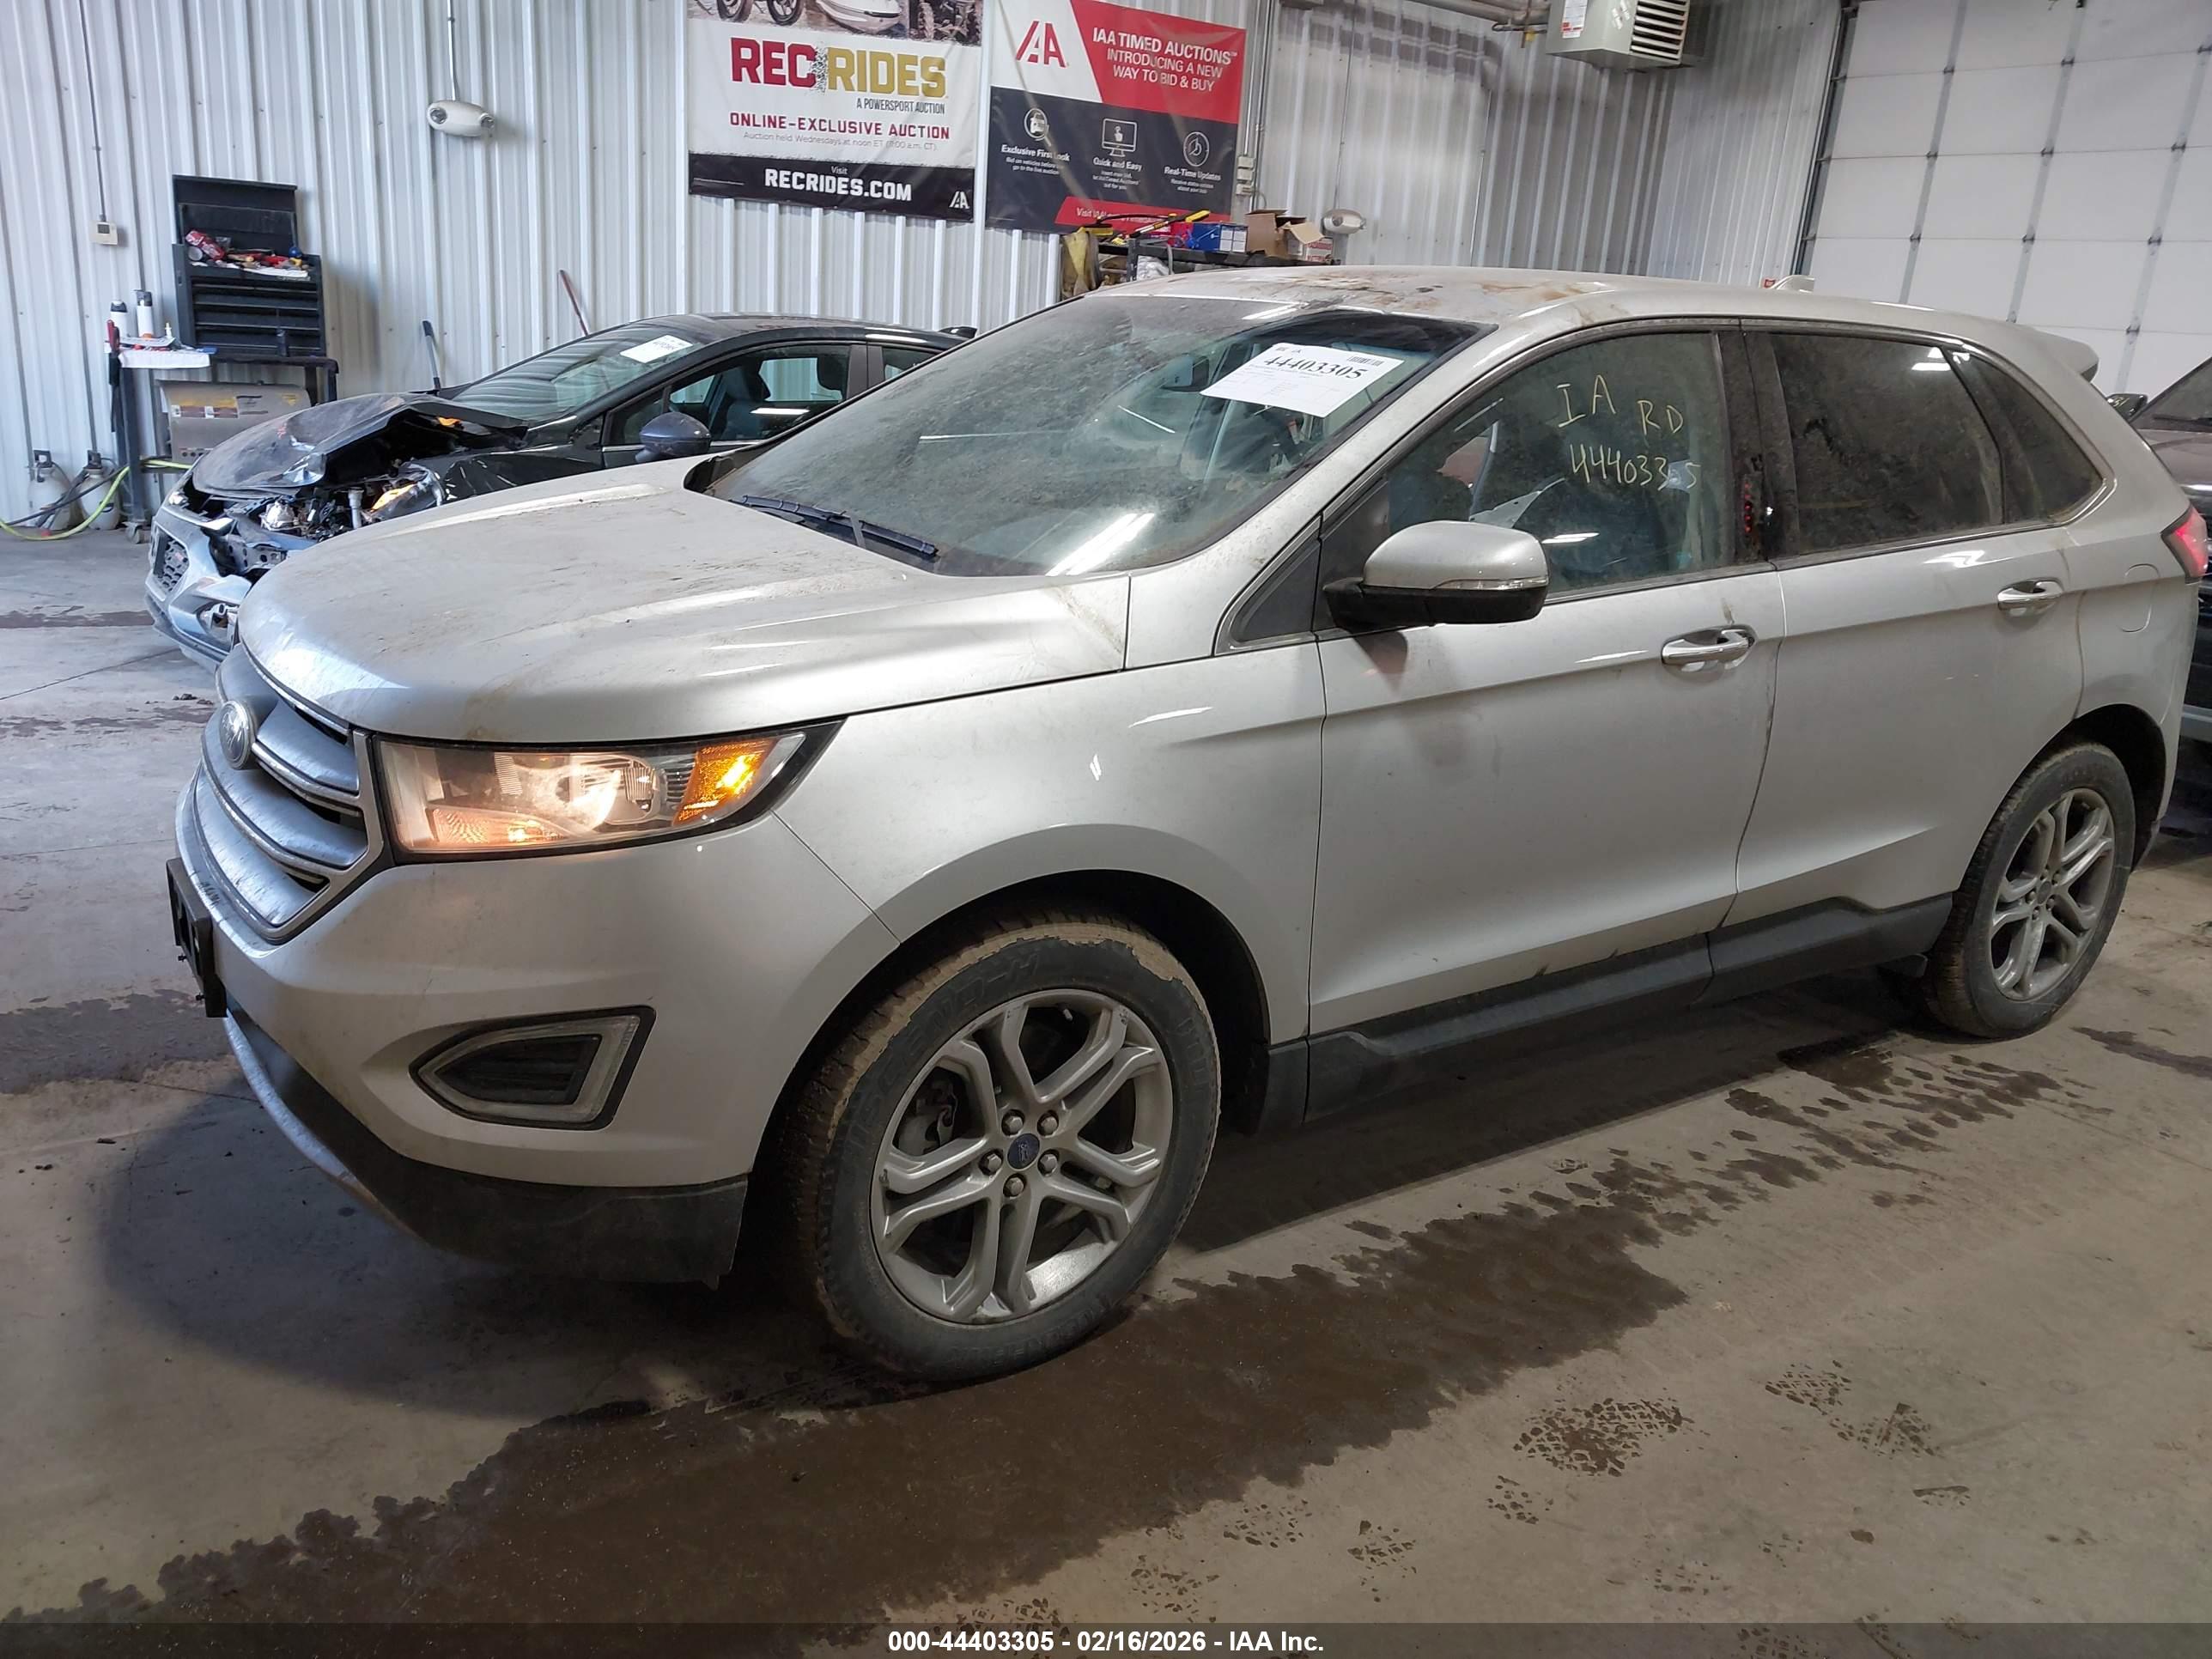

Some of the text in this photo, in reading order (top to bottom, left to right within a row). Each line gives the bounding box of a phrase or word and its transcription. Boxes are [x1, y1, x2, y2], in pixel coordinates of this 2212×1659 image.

[1092, 27, 1116, 46] IAA
[1118, 32, 1162, 52] TIMED
[1107, 48, 1223, 78] INTRODUCING A NEW
[1113, 64, 1215, 92] WAY TO BID & BUY
[857, 98, 945, 114] A POWERSPORT AUCTION
[730, 112, 951, 140] ONLINE-EXCLUSIVE AUCTION
[744, 131, 774, 142] Auction
[775, 133, 793, 143] held
[796, 135, 842, 146] Wednesdays
[852, 138, 871, 147] noon
[873, 139, 884, 148] ET
[1001, 144, 1036, 157] Exclusive
[831, 166, 848, 175] Visit
[1093, 157, 1111, 167] Quick
[1126, 161, 1142, 172] Easy
[1164, 166, 1221, 181] Real-Time Updates
[764, 168, 912, 202] RECRIDES.COM
[1076, 207, 1092, 218] Visit
[1264, 356, 1369, 380] 44403305
